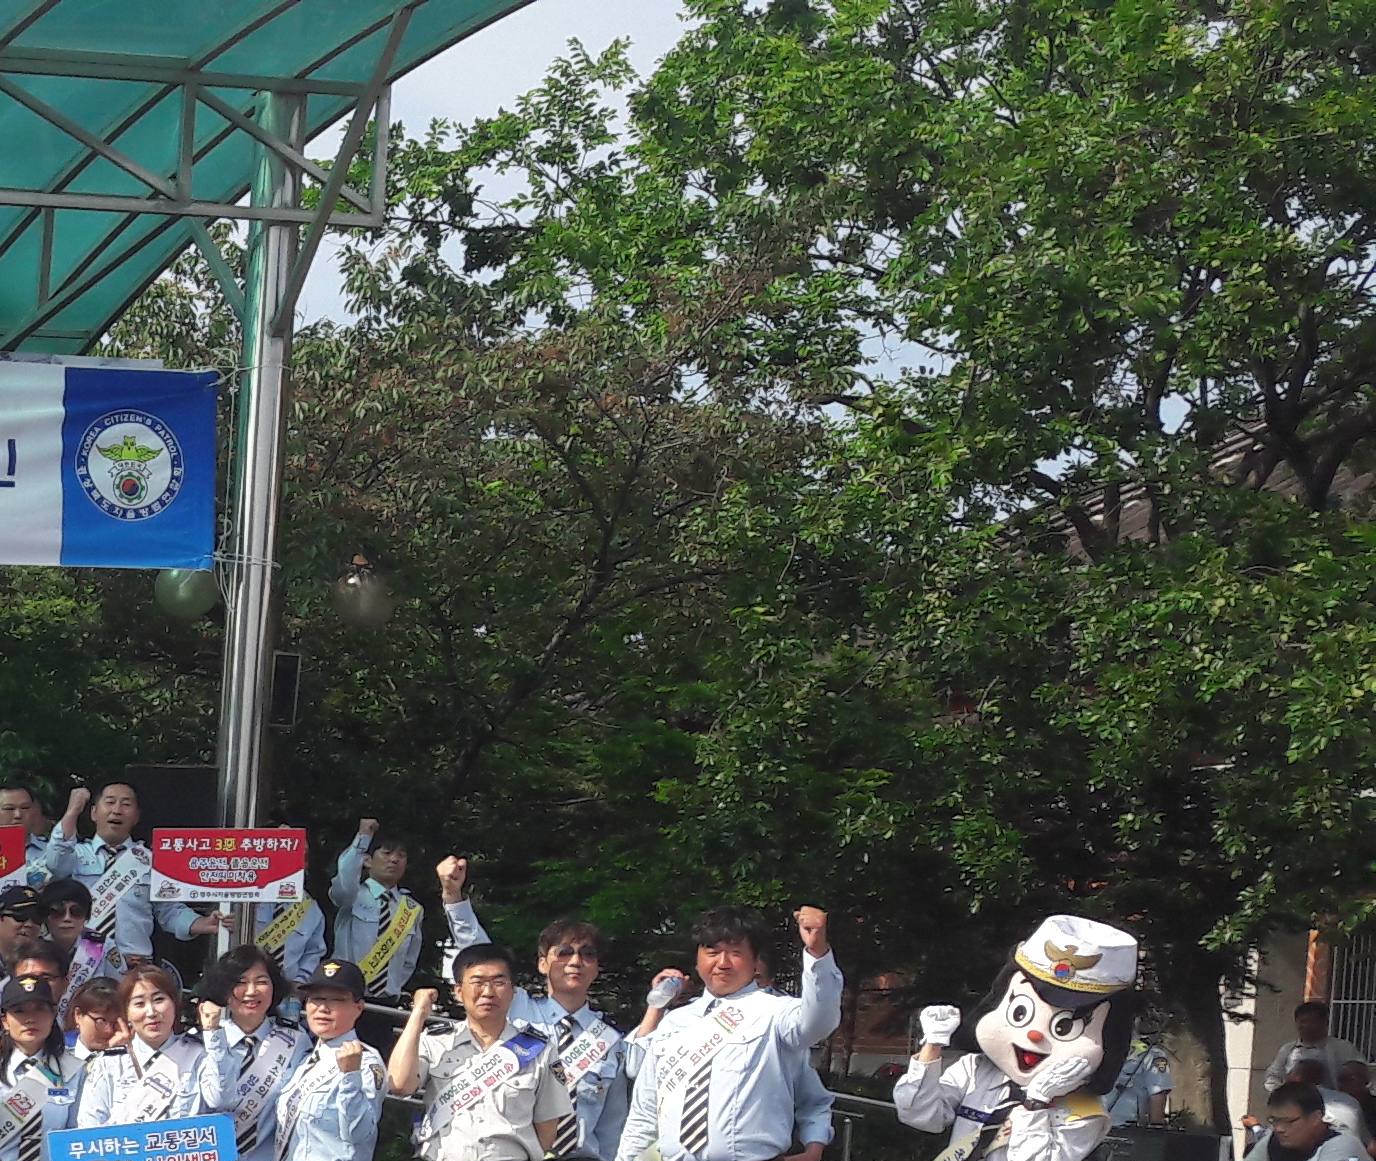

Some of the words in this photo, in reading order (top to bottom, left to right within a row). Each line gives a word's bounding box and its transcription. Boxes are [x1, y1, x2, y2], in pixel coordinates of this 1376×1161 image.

[159, 837, 211, 851] 교통사고
[239, 837, 299, 852] 추방하자!
[468, 1050, 503, 1082] 당신의
[574, 1036, 609, 1074] 속도를
[253, 1052, 288, 1099] 최소한의
[482, 1059, 516, 1090] 속도를
[69, 1138, 140, 1159] 무시하는
[144, 1126, 217, 1152] 교통질서
